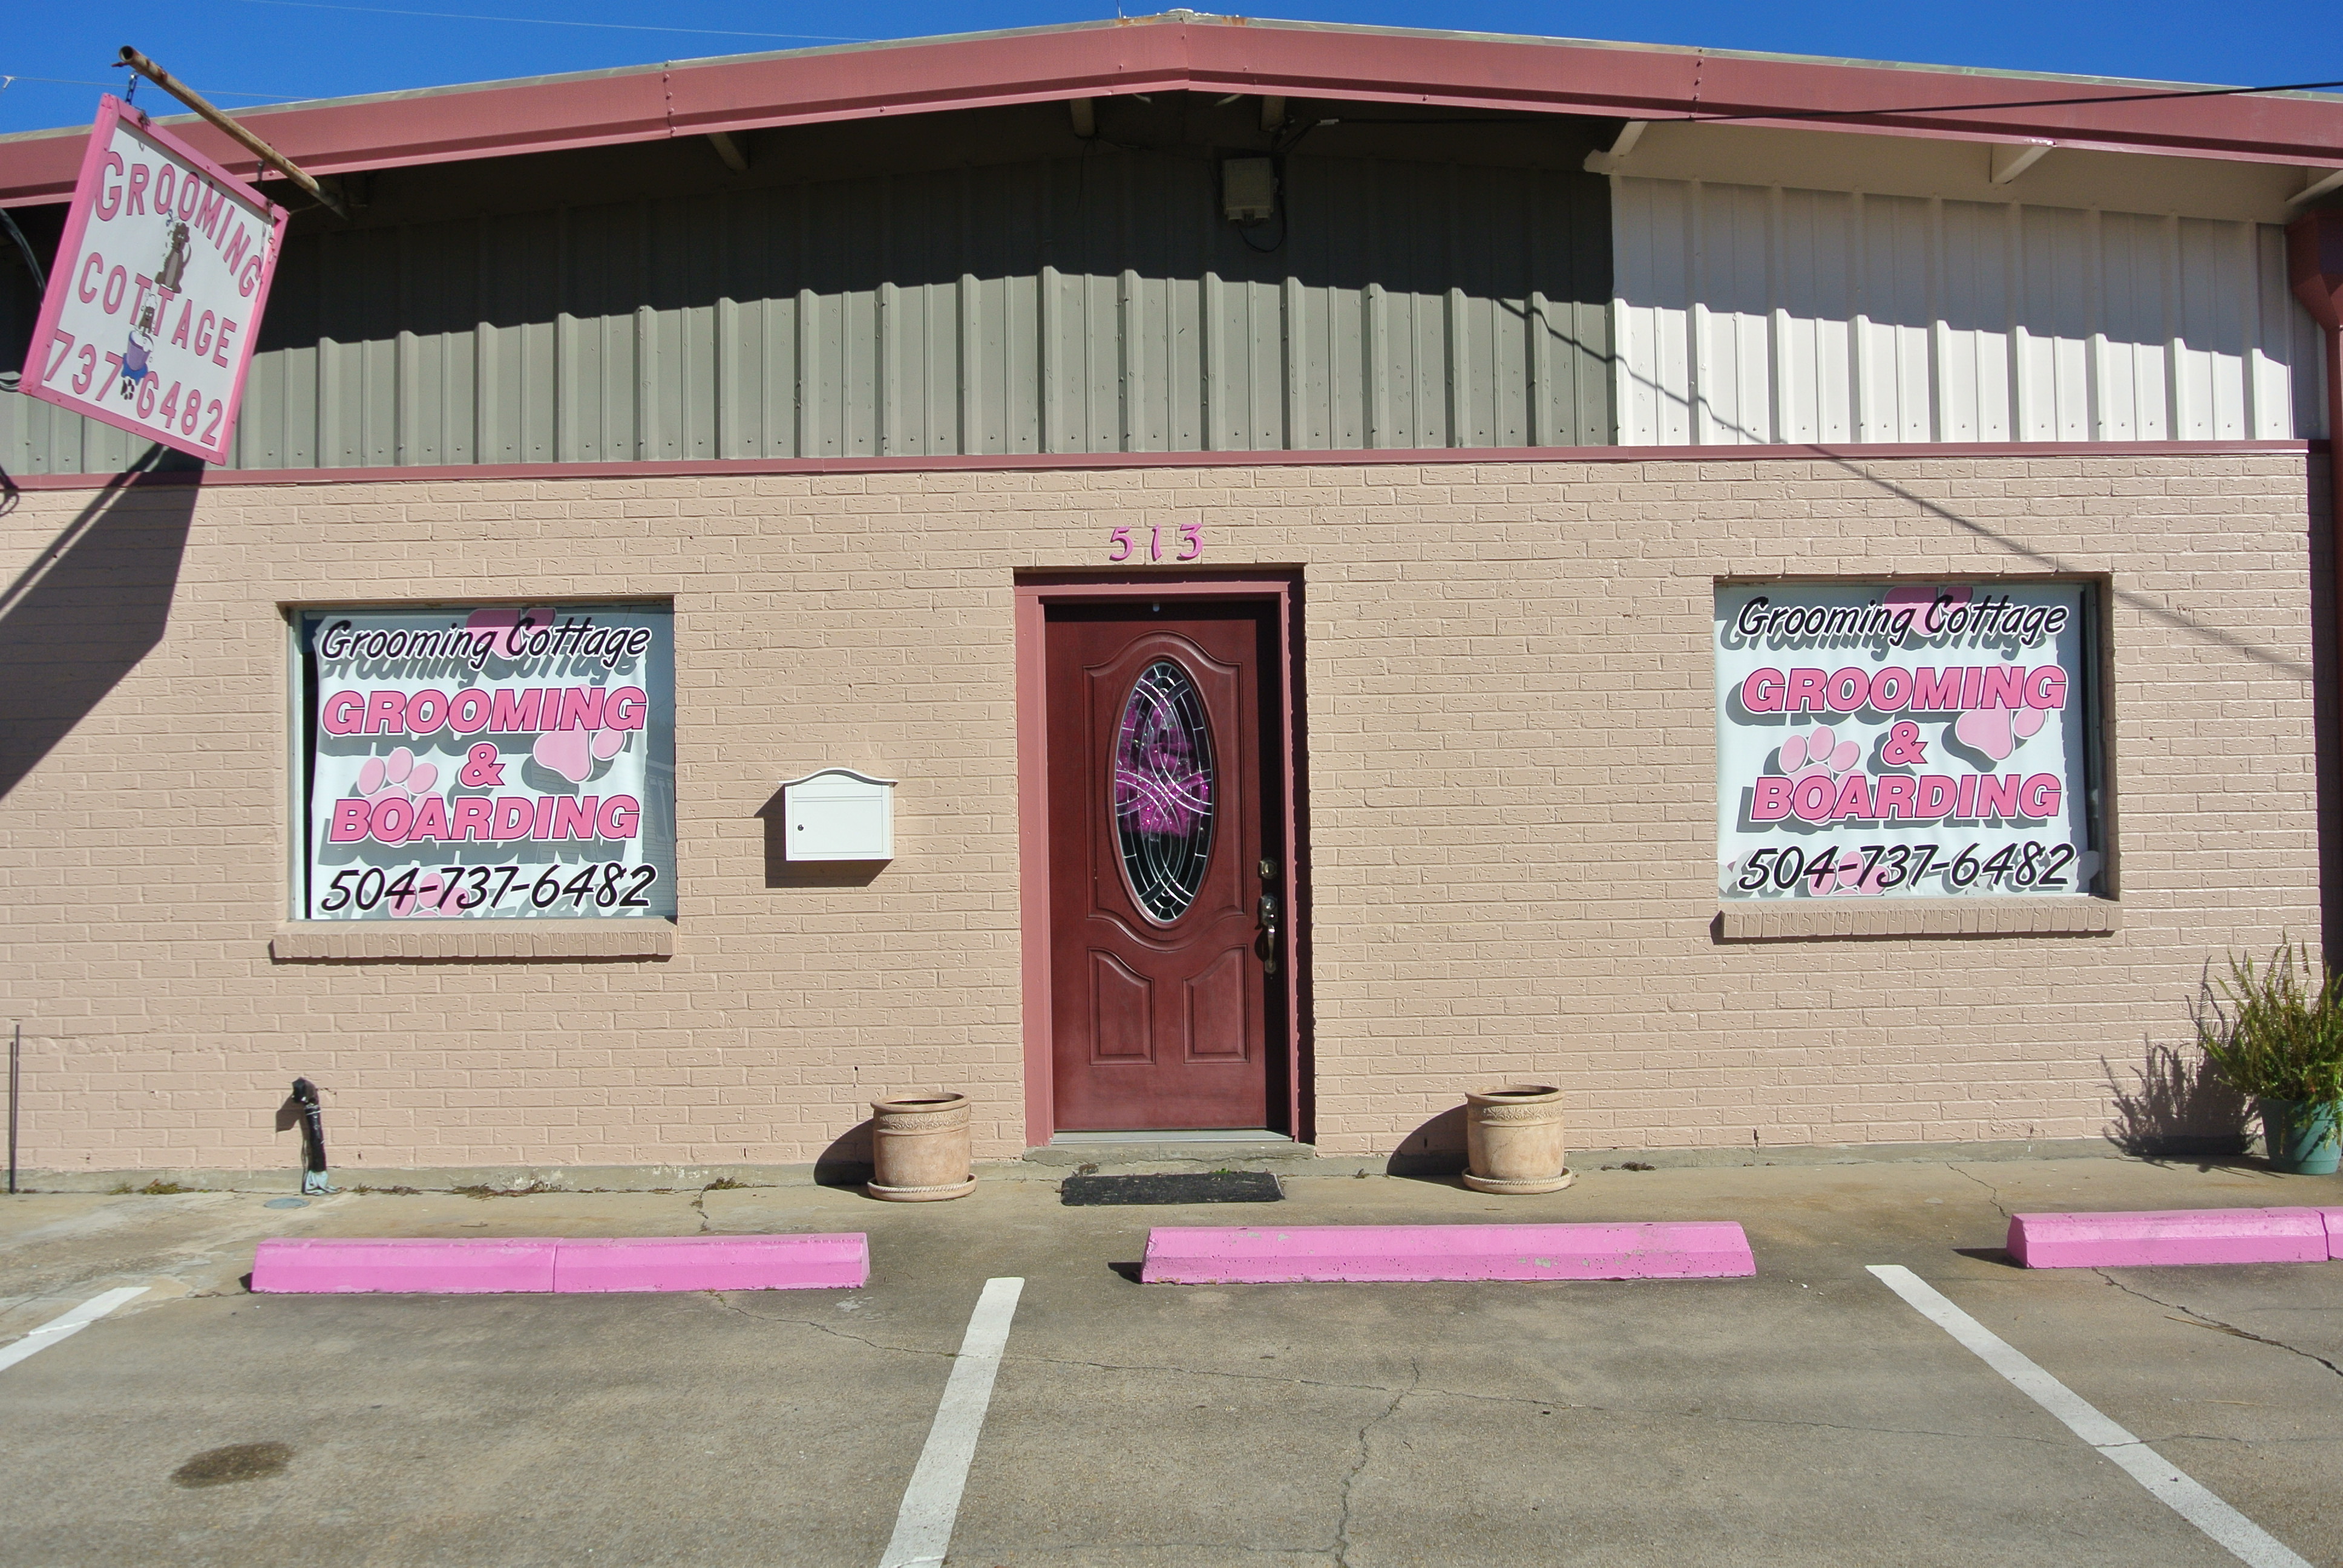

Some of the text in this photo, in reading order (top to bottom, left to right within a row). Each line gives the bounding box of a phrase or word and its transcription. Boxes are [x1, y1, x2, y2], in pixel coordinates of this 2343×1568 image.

[96, 151, 263, 297] GROOMING
[79, 252, 237, 368] COTTAGE
[137, 371, 223, 446] 6482
[1109, 523, 1203, 561] 513
[322, 617, 650, 668] Grooming Cottage
[1738, 595, 2066, 645] Grooming Cottage
[323, 687, 647, 734] GROOMING
[1742, 665, 2067, 711] GROOMING
[460, 743, 505, 787] &
[1883, 721, 1928, 765] &
[330, 795, 640, 842] BOARDING
[1751, 773, 2061, 820] BOARDING
[321, 863, 656, 911] 504-737-6482
[1738, 840, 2076, 889] 504-737-6482
